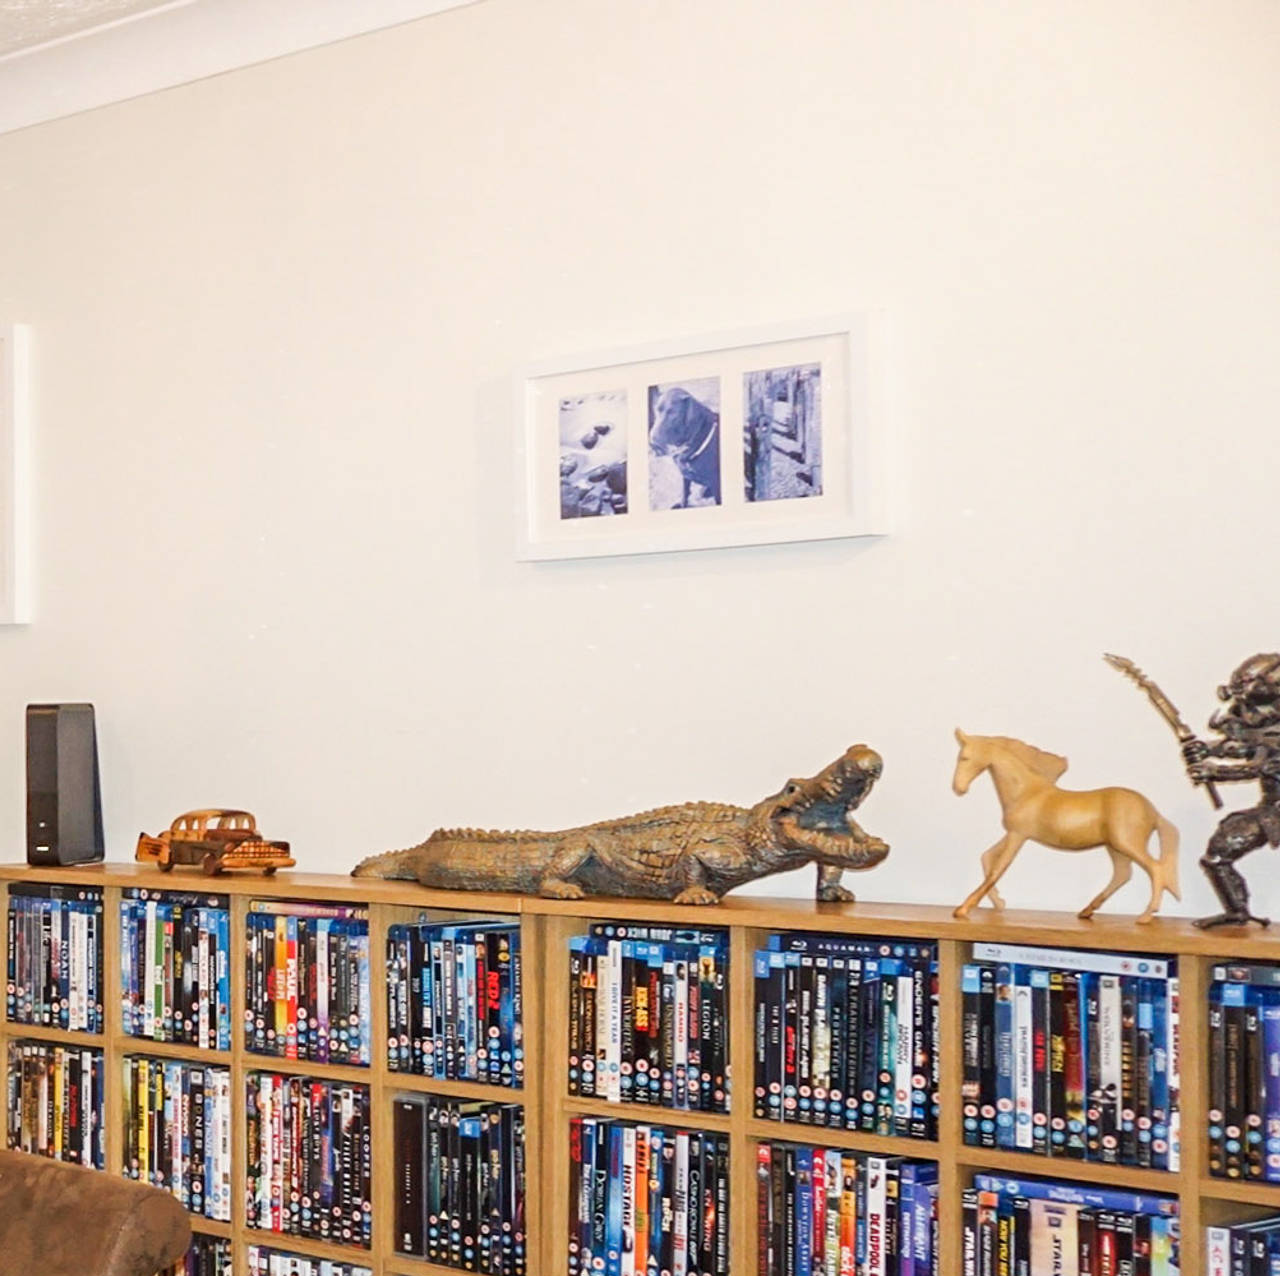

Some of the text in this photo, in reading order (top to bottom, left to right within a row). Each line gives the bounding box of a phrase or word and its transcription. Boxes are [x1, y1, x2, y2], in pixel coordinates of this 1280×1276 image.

[286, 958, 298, 1001] PAUL
[832, 1007, 840, 1079] PROMETHEUS
[914, 970, 924, 1067] ENDER'S GAME
[622, 1163, 633, 1227] HOSTAGE
[826, 1209, 839, 1244] PETER
[868, 1212, 882, 1270] DEADPOOL
[1000, 1219, 1009, 1238] NOW
[1000, 1241, 1009, 1260] YOU
